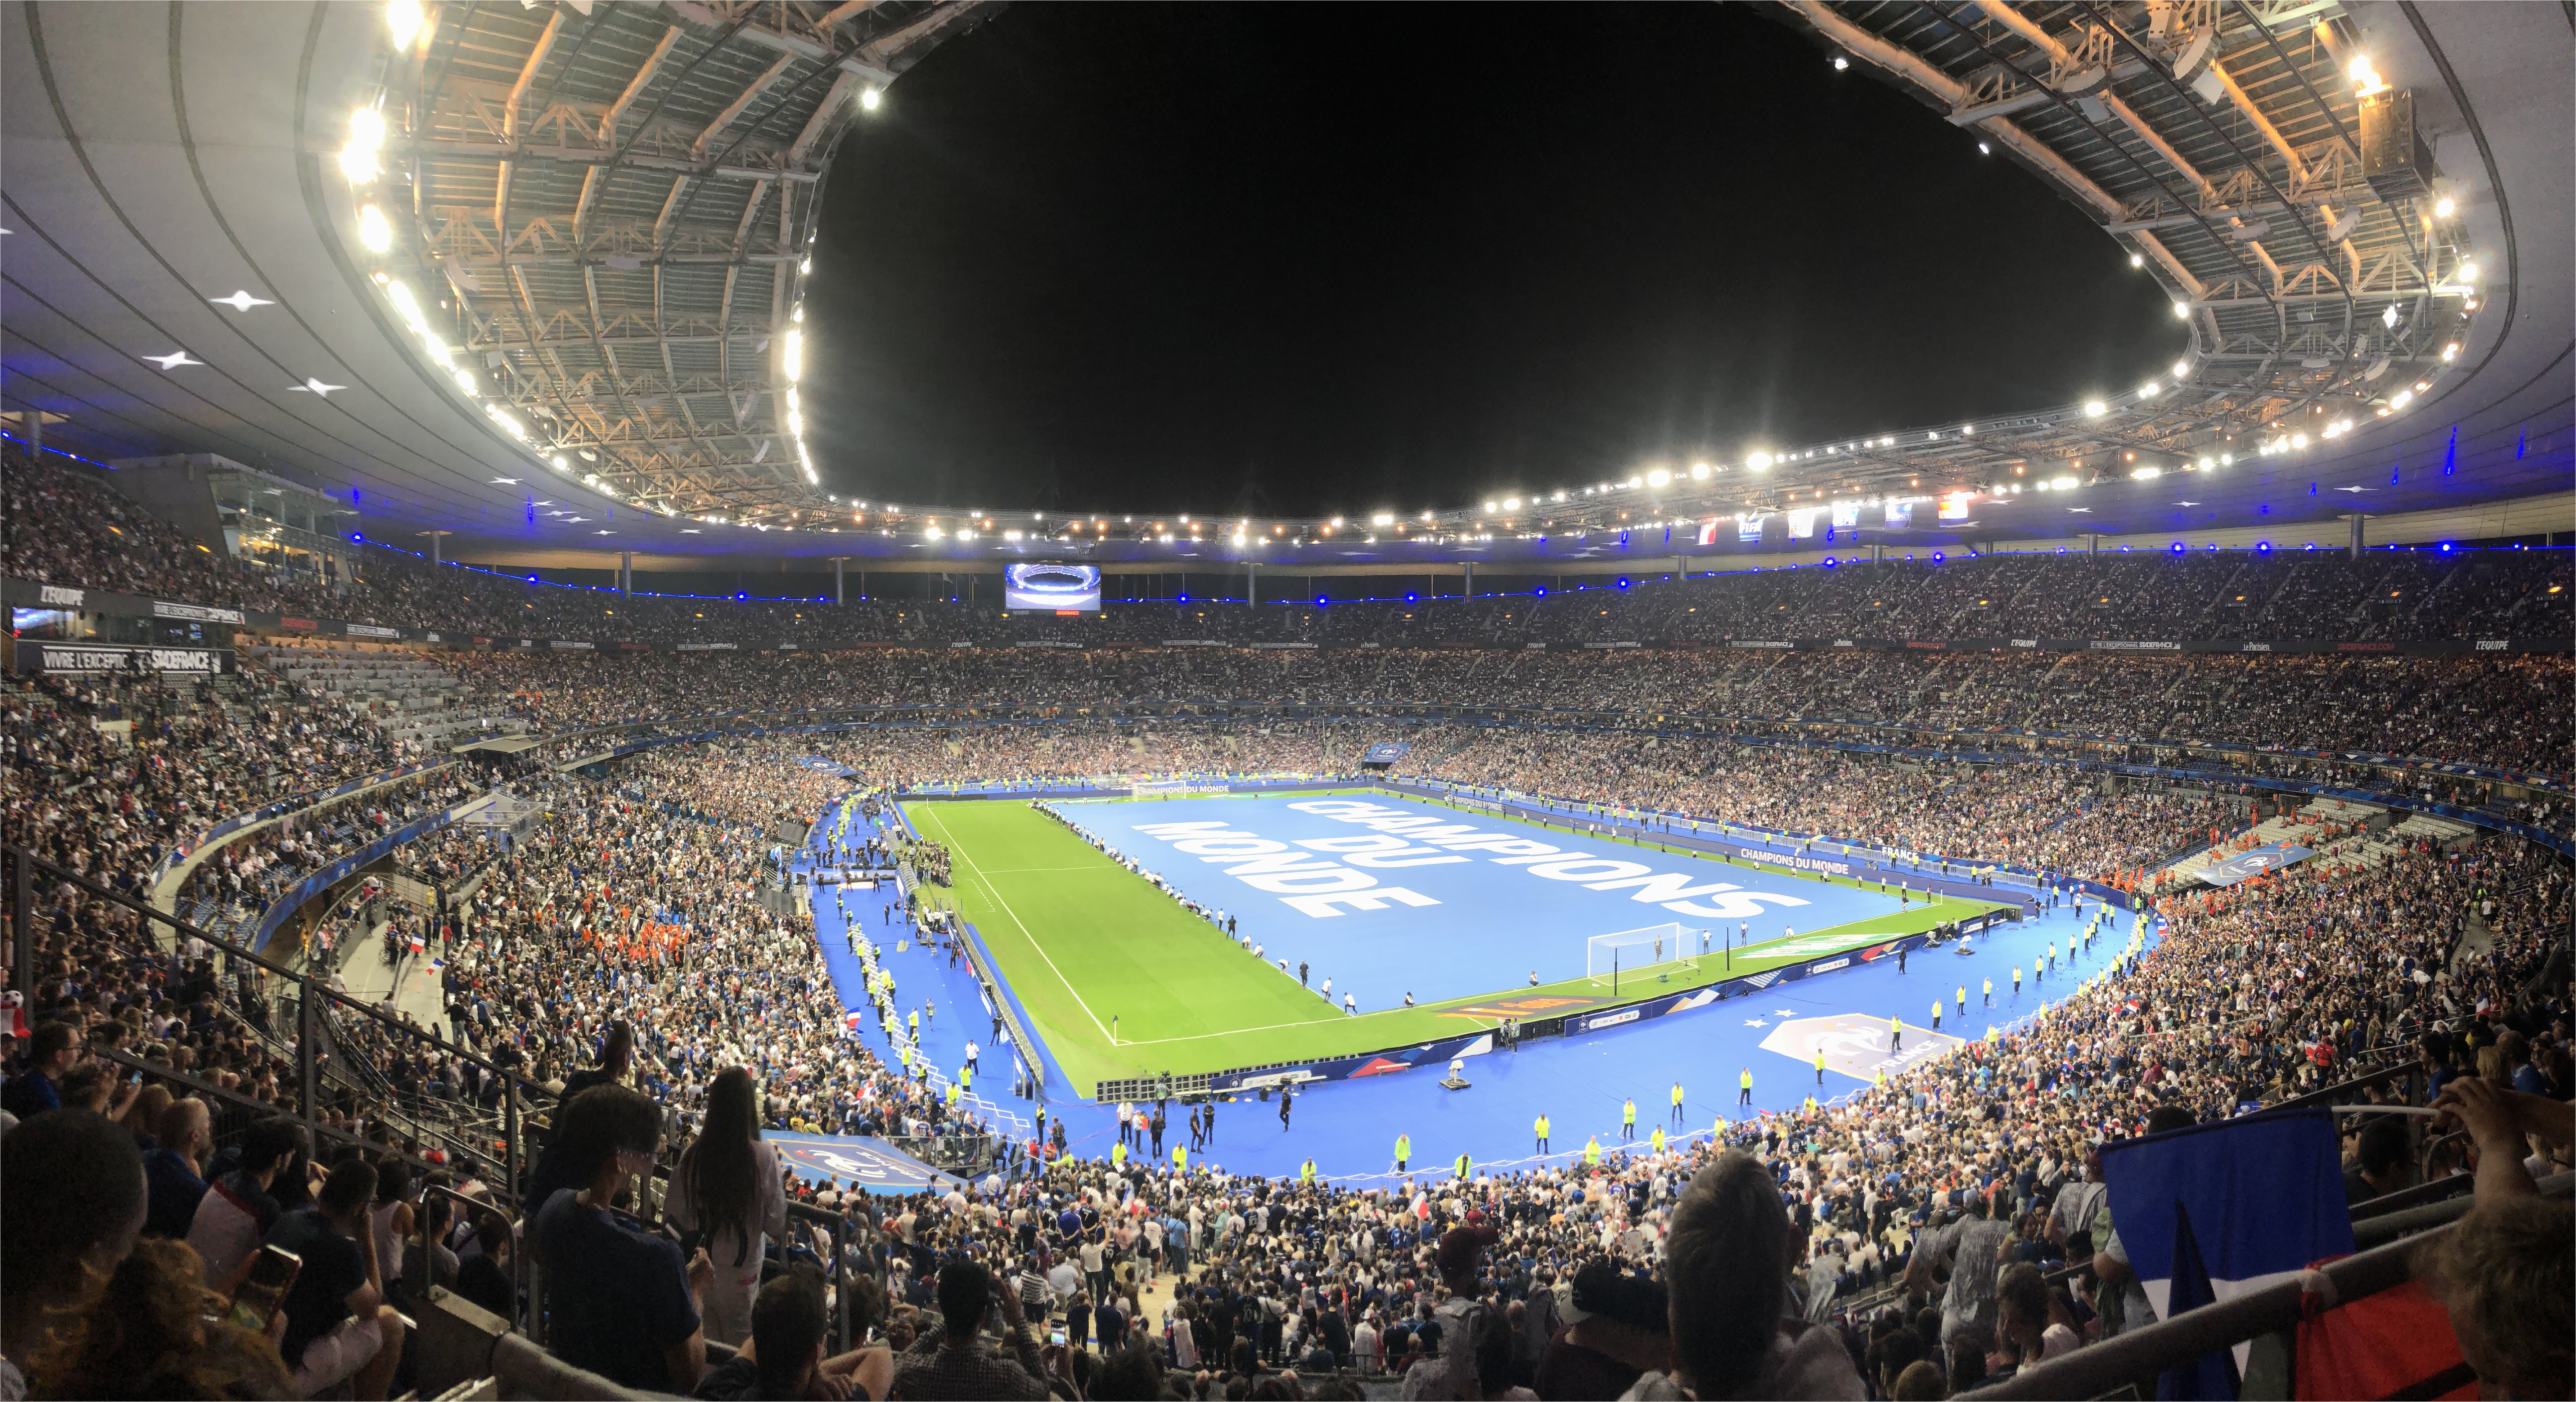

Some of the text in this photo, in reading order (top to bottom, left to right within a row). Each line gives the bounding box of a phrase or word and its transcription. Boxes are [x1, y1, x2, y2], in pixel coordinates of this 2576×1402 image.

[2011, 639, 2037, 647] L'EQUIPE
[2249, 641, 2269, 650] Parisien
[2476, 641, 2509, 650] L'EQUIPE
[1287, 800, 1812, 918] CHAMPIONS
[1290, 834, 1474, 868] DU
[1741, 848, 1848, 874] CHAMPIONS DU MONDE
[1882, 846, 1918, 861] FRANCE
[1130, 821, 1443, 918] MONDE
[2226, 866, 2247, 875] FRANCE
[1870, 1040, 1941, 1072] FRANCE
[856, 1151, 927, 1180] FRANCE
[1084, 1212, 1089, 1221] 7
